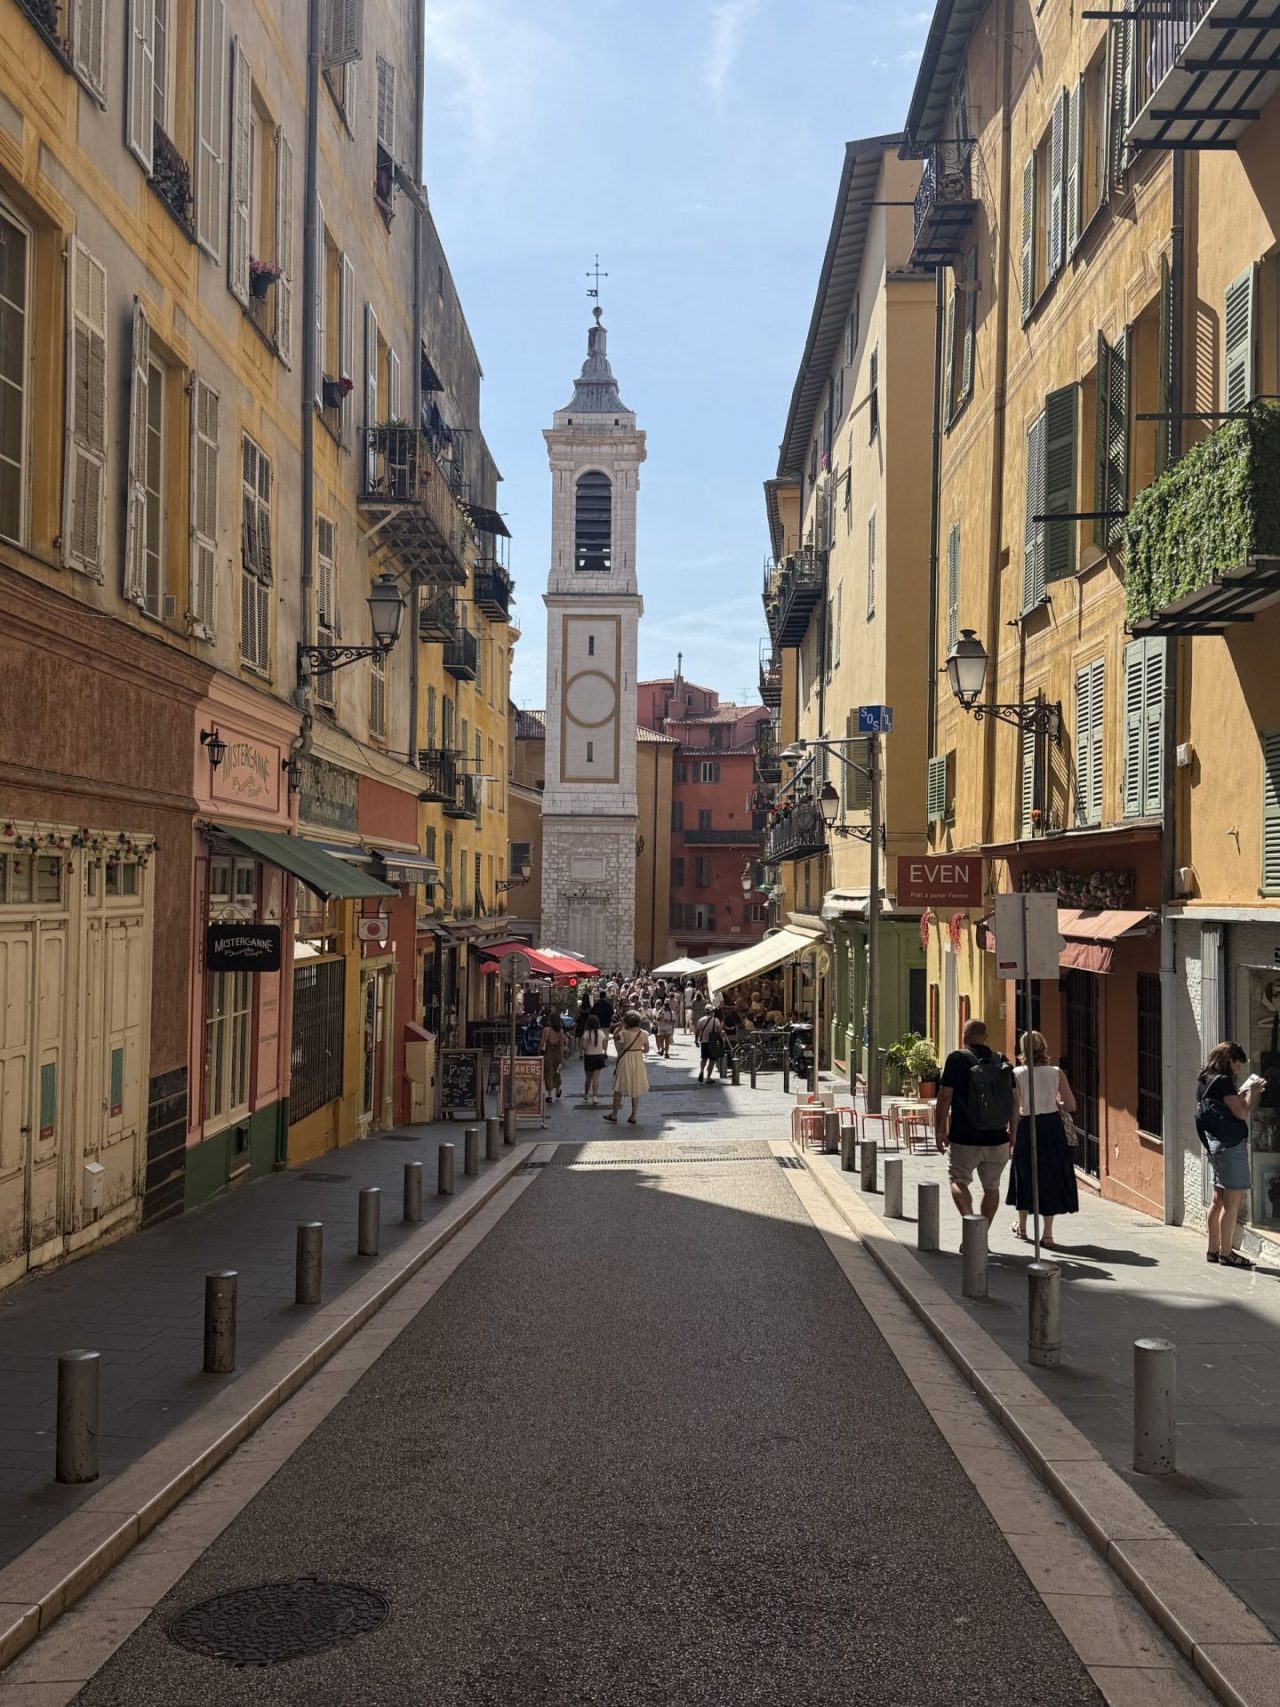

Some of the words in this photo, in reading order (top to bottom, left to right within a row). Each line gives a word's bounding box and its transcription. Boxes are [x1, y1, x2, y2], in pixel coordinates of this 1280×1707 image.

[861, 707, 880, 731] SOS
[910, 864, 969, 883] EVEN
[214, 937, 274, 953] MISTERGANNE
[503, 1064, 541, 1076] SAKERS
